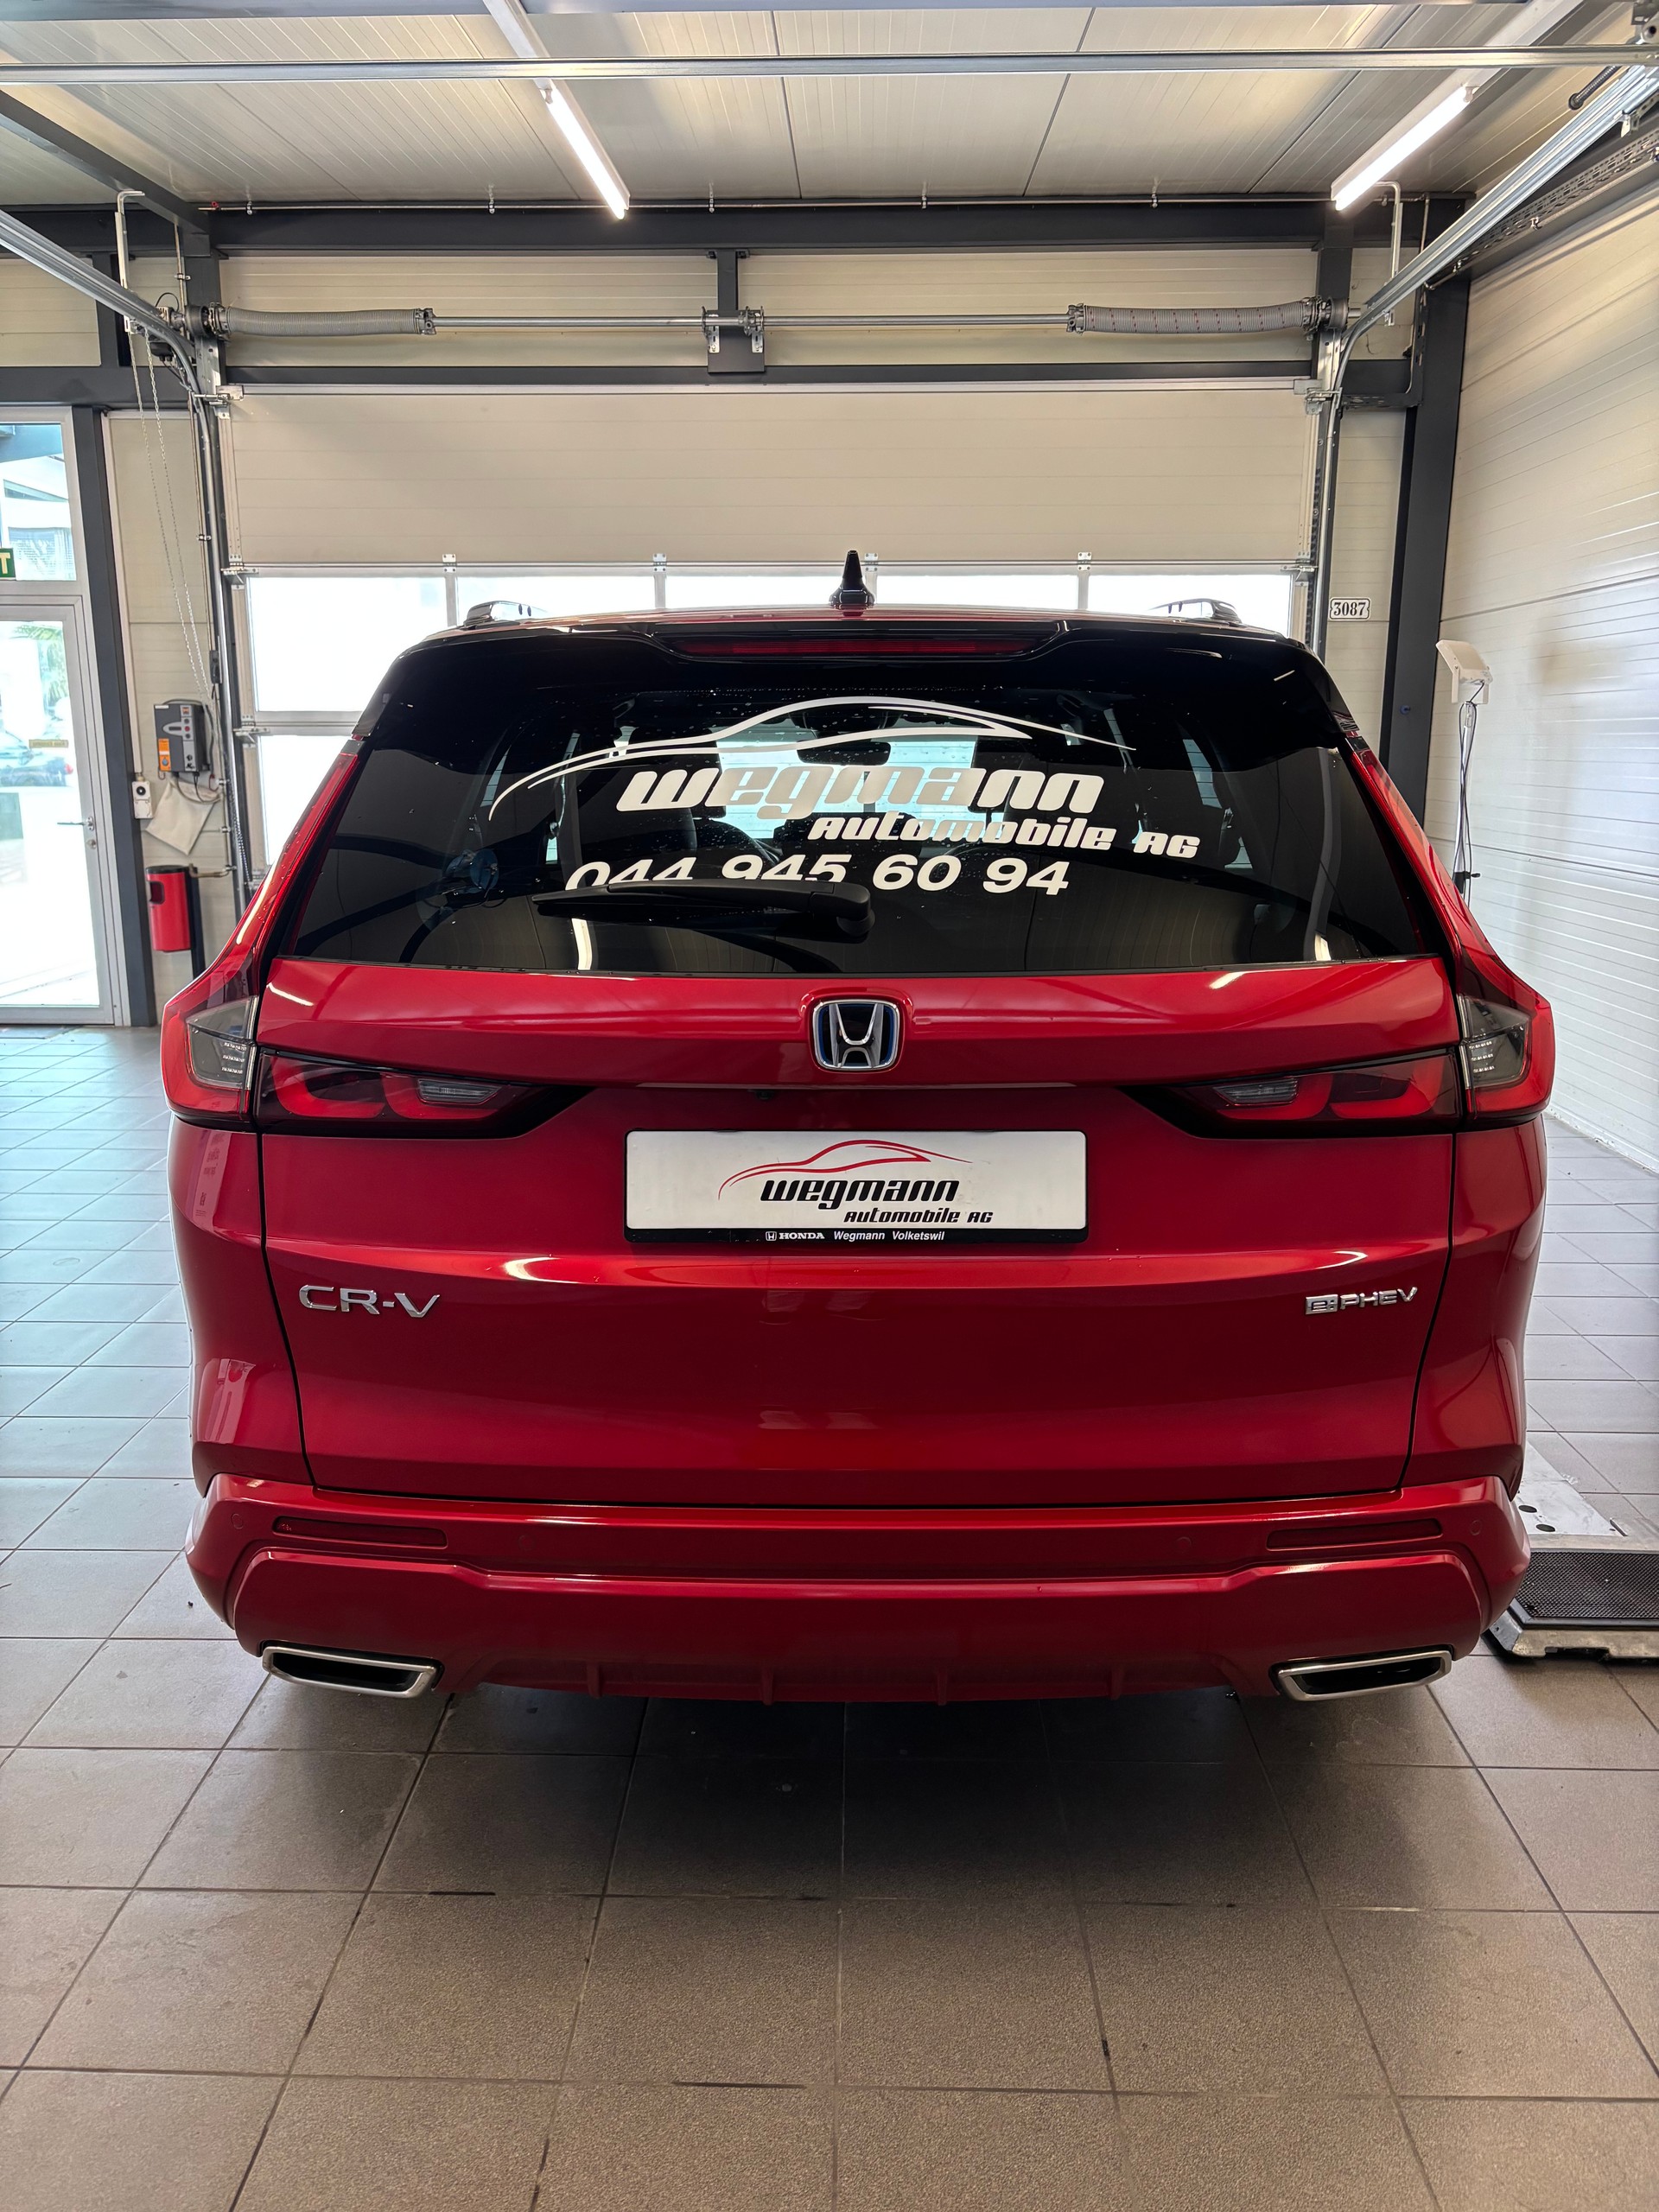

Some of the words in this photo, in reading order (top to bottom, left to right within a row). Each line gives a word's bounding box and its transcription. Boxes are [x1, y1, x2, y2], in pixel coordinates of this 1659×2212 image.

[1333, 601, 1367, 616] 3087
[616, 766, 1104, 820] wegmann
[1134, 831, 1200, 858] AG
[565, 858, 696, 890] 044
[721, 855, 852, 882] 945
[873, 855, 962, 892] 60
[982, 858, 1070, 896] 94
[760, 1180, 959, 1210] wegmann
[967, 1211, 993, 1224] AG
[833, 1230, 885, 1243] Wegmann
[892, 1230, 945, 1241] Volketswil
[299, 1284, 441, 1319] CR-V
